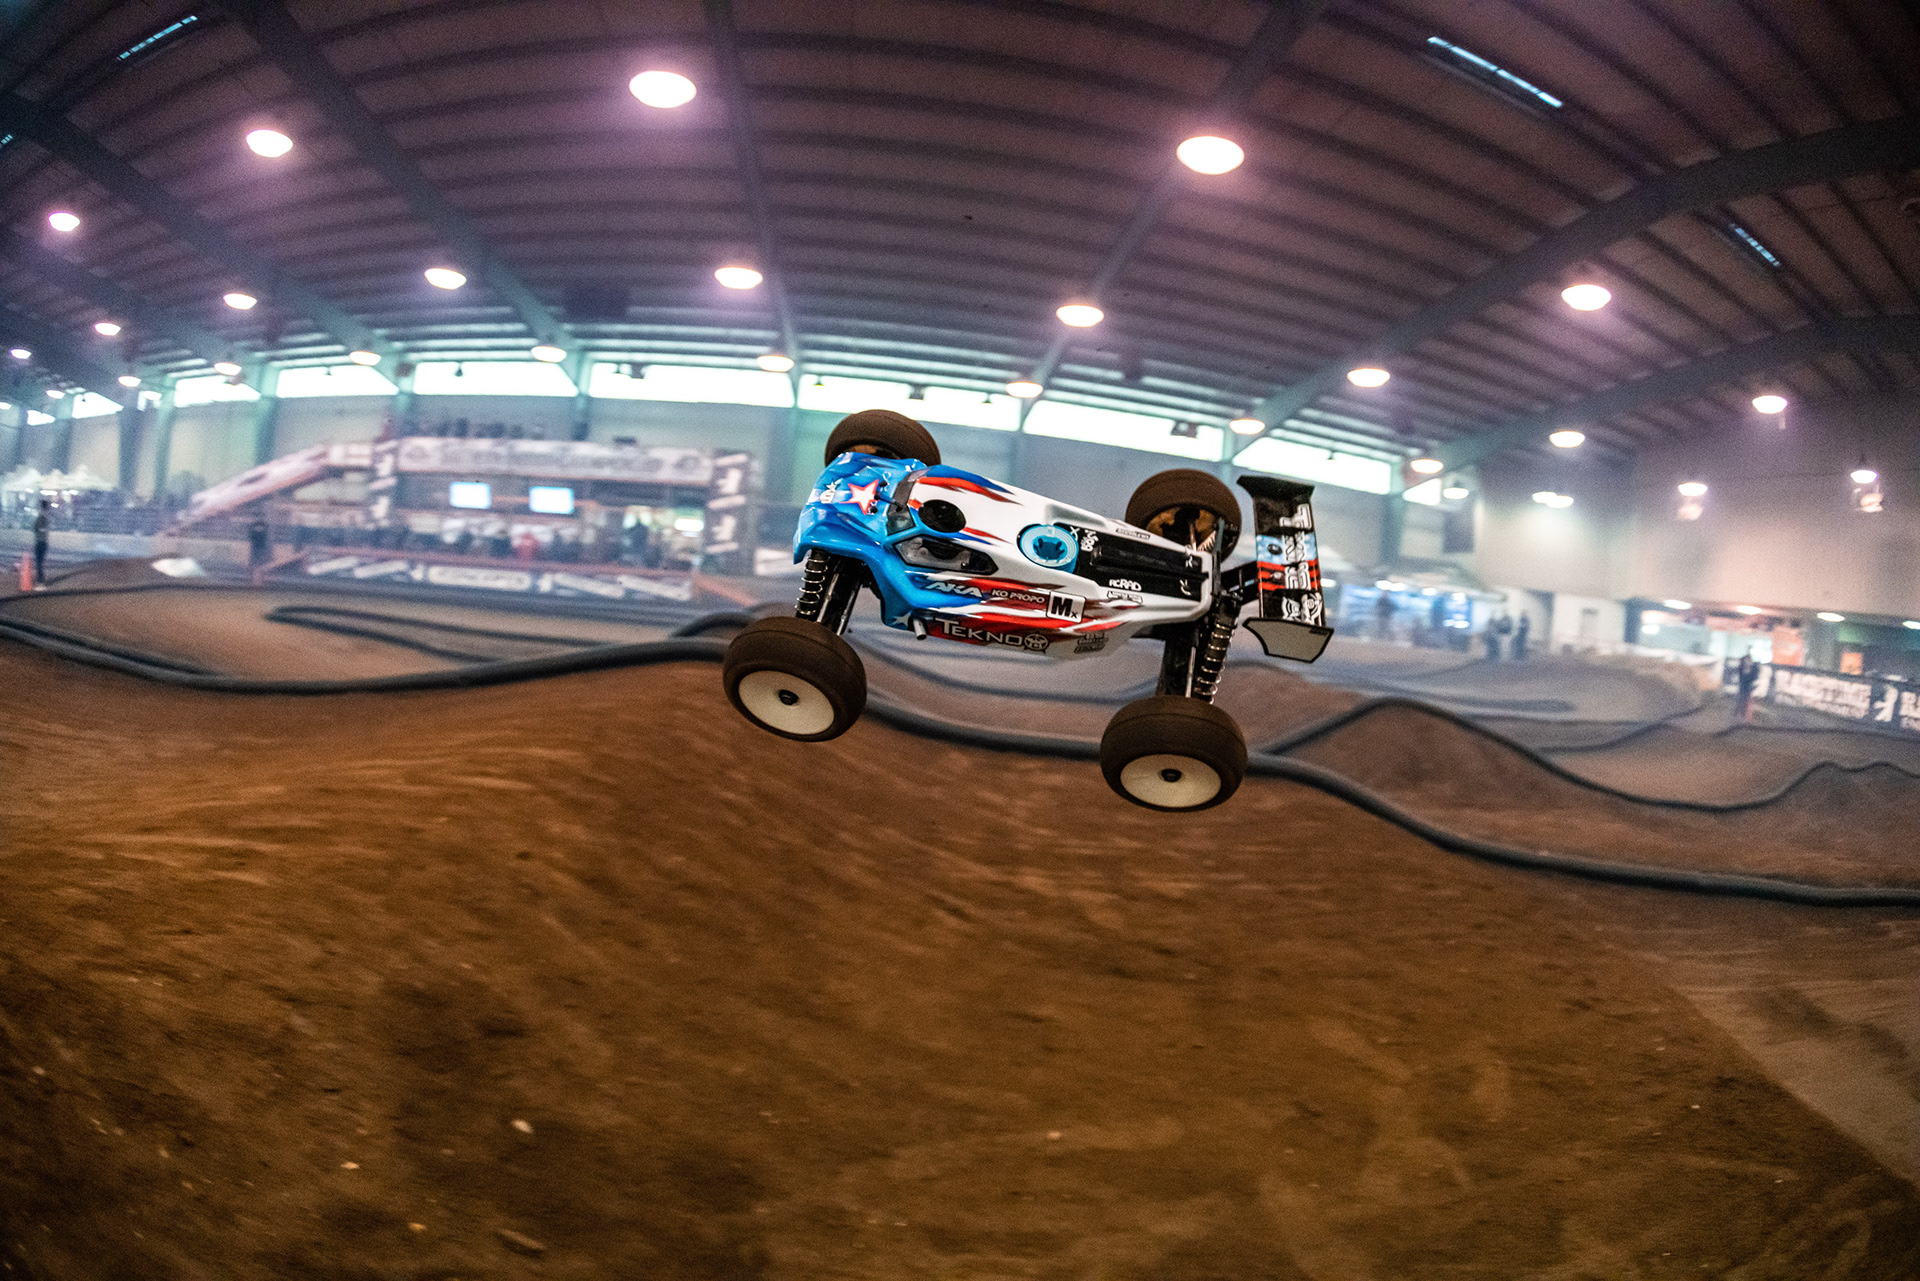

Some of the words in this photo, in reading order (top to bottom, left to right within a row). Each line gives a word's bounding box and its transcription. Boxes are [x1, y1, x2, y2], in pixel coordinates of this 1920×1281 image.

[924, 581, 983, 598] AKA
[991, 588, 1009, 598] KO
[1009, 591, 1045, 604] PROPO
[935, 617, 1023, 647] TEKNO
